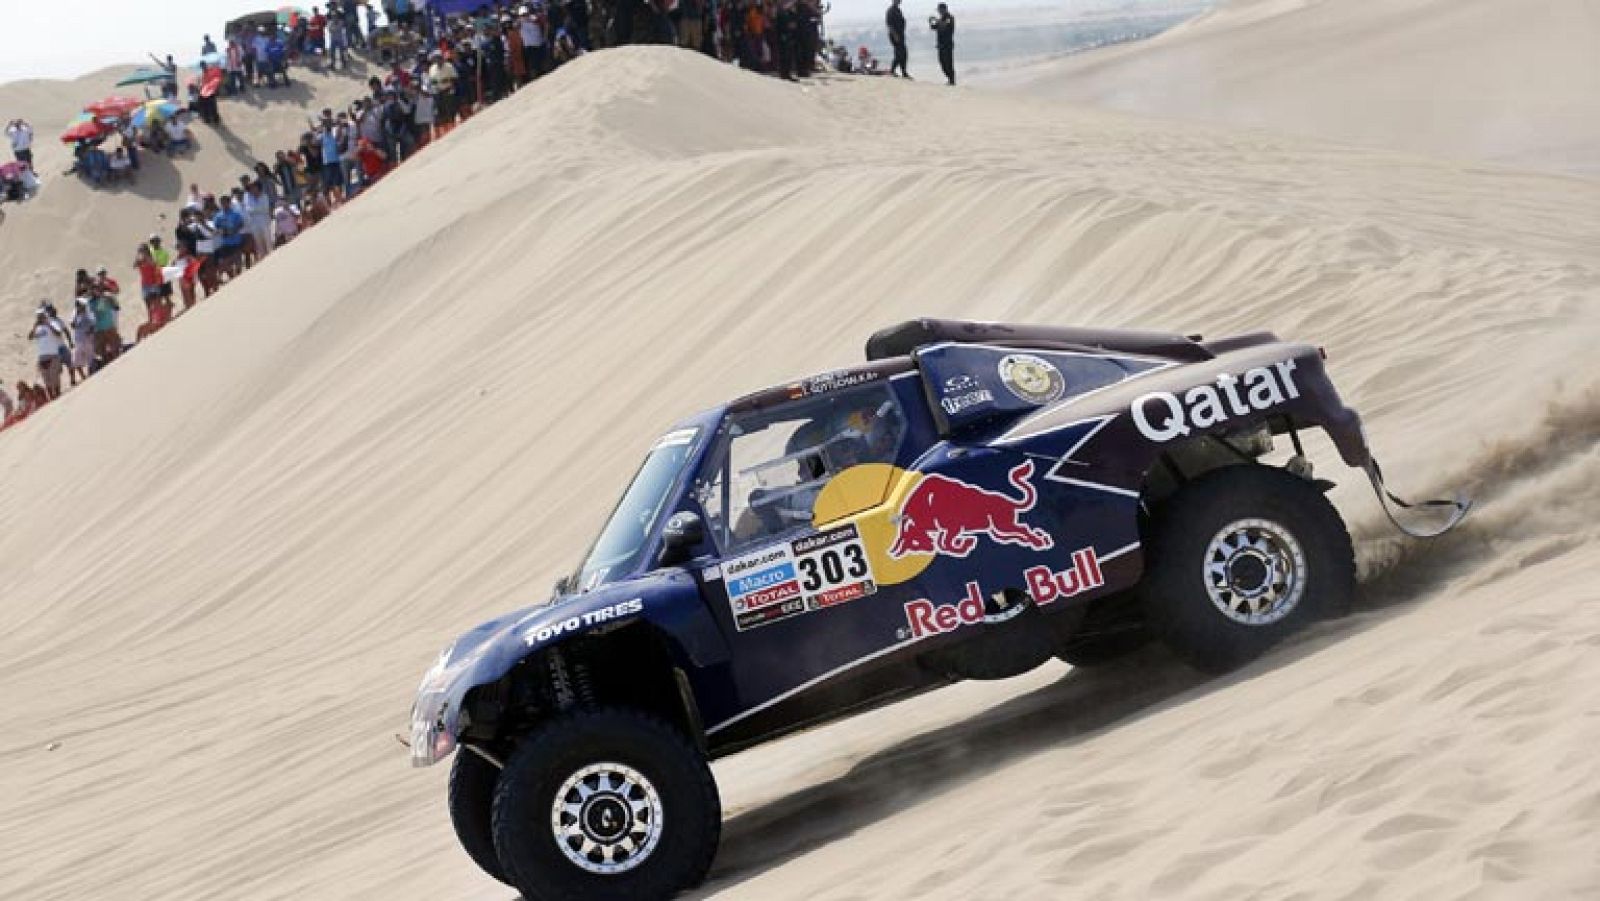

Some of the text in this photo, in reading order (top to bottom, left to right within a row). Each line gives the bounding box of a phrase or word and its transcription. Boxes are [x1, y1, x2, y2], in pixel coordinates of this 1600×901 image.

[1131, 358, 1300, 441] Qatar
[795, 527, 857, 551] dakar.com
[727, 550, 786, 574] dakar.com
[799, 543, 868, 591] 303
[738, 569, 785, 593] Macro
[749, 585, 798, 606] TOTAL
[904, 546, 1105, 638] Red Bull
[524, 598, 643, 647] TOYO TIRES
